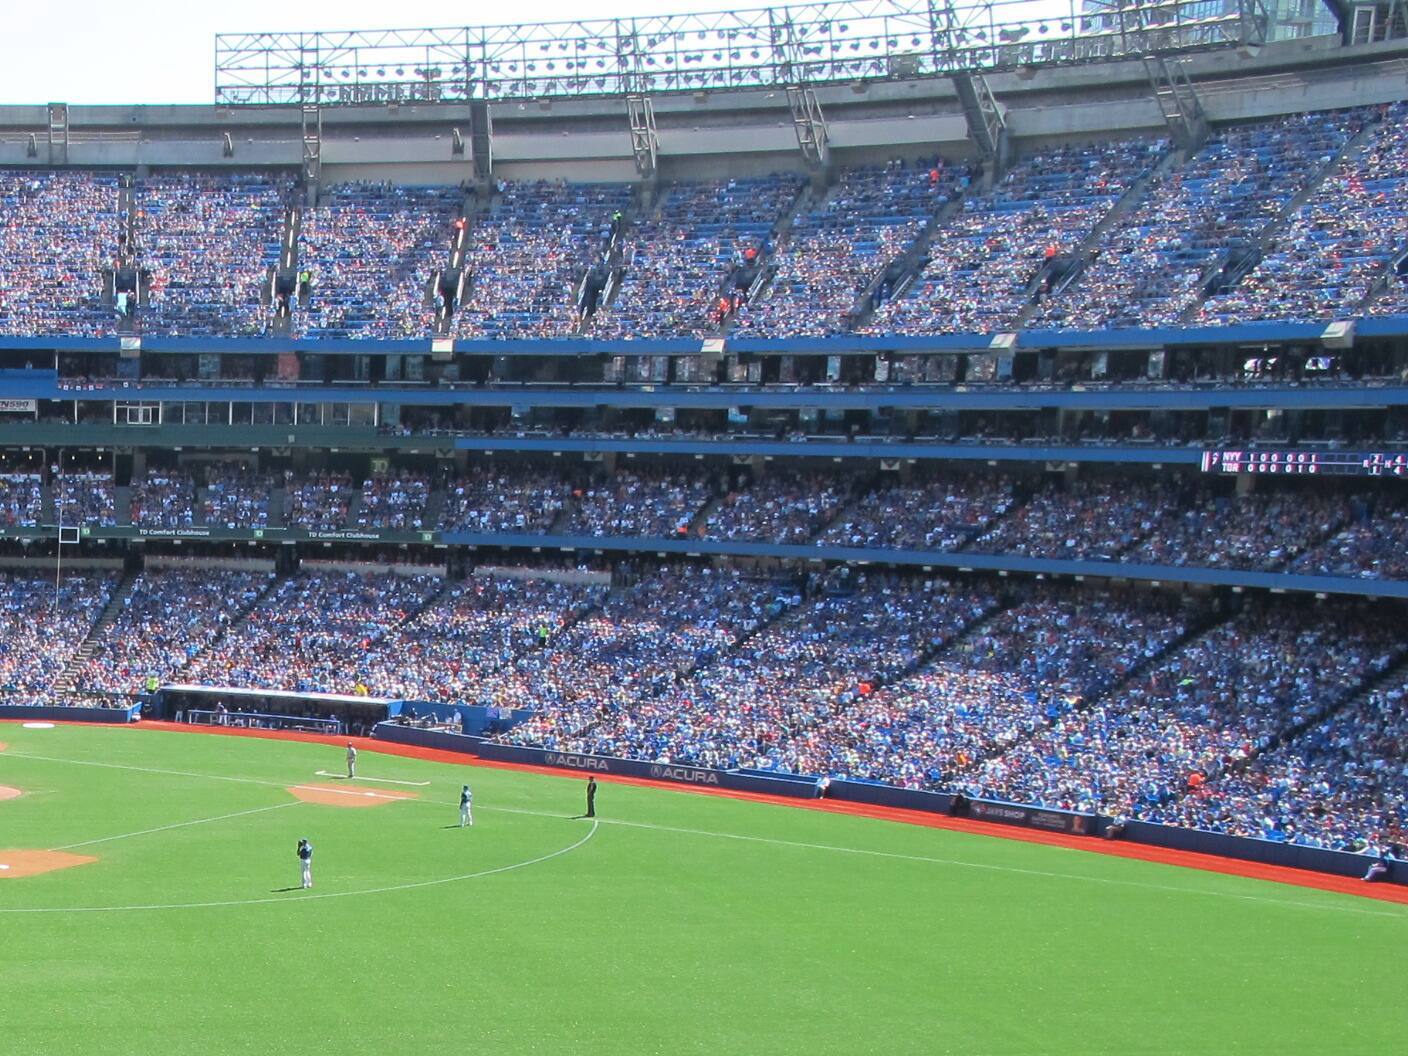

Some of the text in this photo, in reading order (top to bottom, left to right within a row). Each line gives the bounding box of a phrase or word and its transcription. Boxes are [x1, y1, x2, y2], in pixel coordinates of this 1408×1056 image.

[1222, 451, 1242, 461] NYY
[1221, 463, 1239, 472] TOR
[556, 755, 609, 770] ACURA
[662, 769, 719, 784] ACURA
